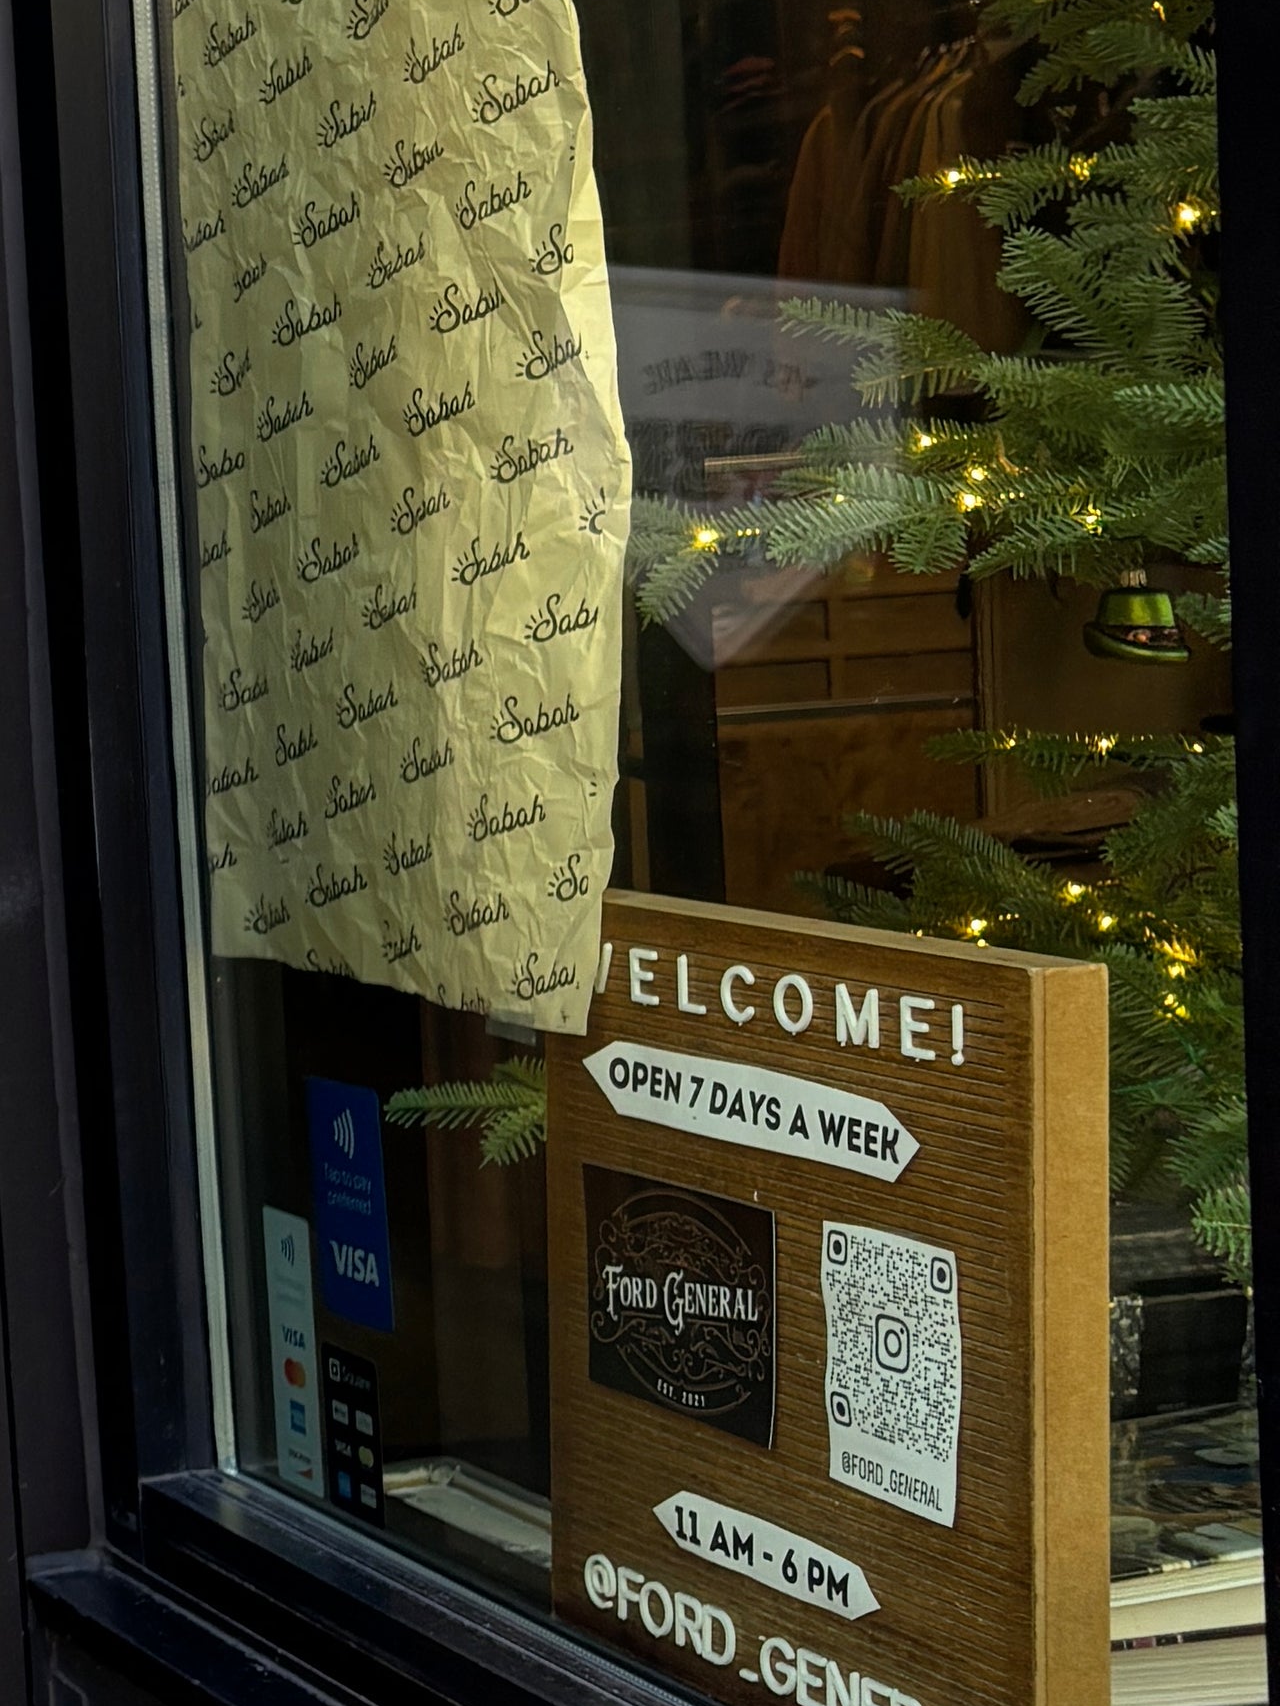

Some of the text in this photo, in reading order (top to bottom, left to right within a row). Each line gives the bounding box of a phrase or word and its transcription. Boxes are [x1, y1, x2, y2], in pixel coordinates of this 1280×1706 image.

[481, 60, 560, 125] Sabah
[301, 191, 360, 248] Sabah
[459, 171, 532, 231] Sabah
[278, 292, 342, 346] Sabah
[525, 330, 582, 380] Sba
[408, 381, 476, 437] Sabah
[197, 445, 246, 488] Saba
[496, 427, 574, 484] Sabah
[201, 531, 231, 569] bah
[532, 594, 599, 643] Sab
[427, 639, 483, 688] Sabah
[340, 680, 398, 729] Sabah
[497, 693, 579, 744] Sabah
[207, 758, 259, 795] abah
[472, 793, 546, 842] Sabah
[595, 941, 965, 1066] ELCOME!
[609, 1057, 901, 1165] OPEN 7 DAYS A WEEK
[329, 1239, 380, 1288] VISA
[602, 1264, 759, 1336] FORD GENERAL
[281, 1325, 306, 1351] VISA
[681, 1391, 706, 1408] 2021
[841, 1450, 943, 1513] @FORD_GENERAL
[673, 1504, 701, 1546] 11
[710, 1520, 755, 1567] AM
[781, 1548, 799, 1585] 6
[807, 1557, 850, 1608] PM
